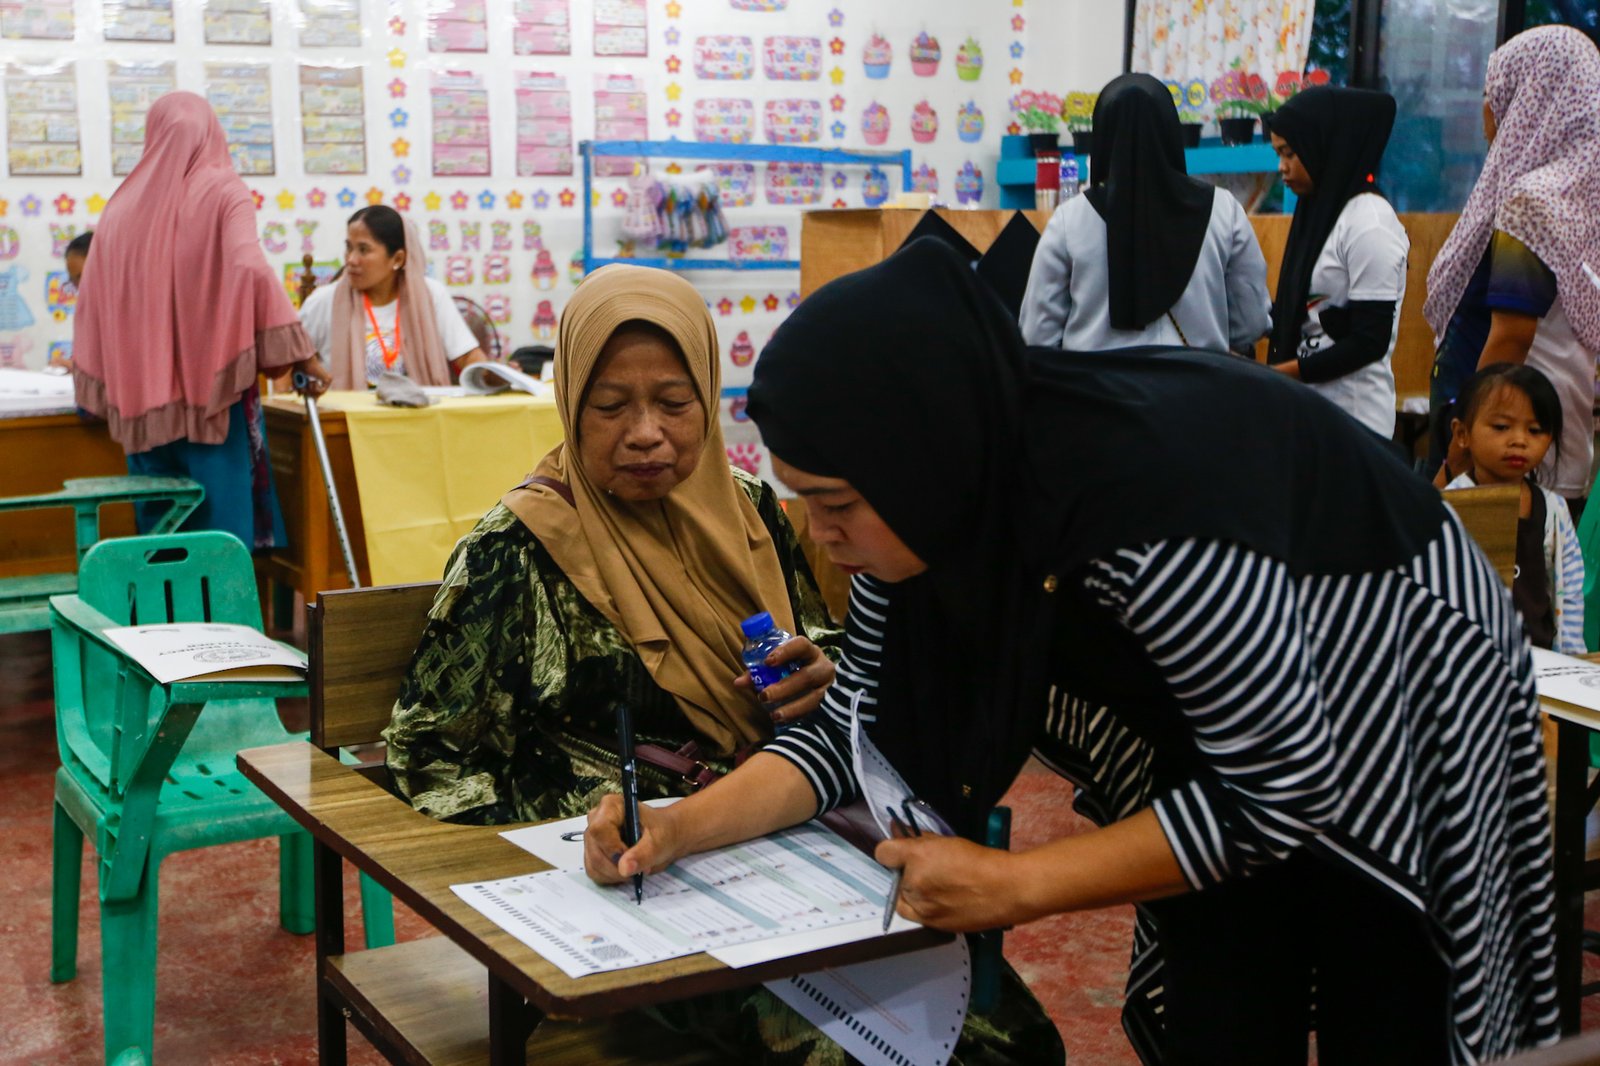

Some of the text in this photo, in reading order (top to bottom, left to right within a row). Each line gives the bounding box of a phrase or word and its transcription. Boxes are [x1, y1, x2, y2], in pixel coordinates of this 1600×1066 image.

[702, 49, 750, 65] Monday
[767, 49, 818, 65] Tuesday
[428, 219, 544, 251] RNER
[736, 240, 785, 257] Sunday
